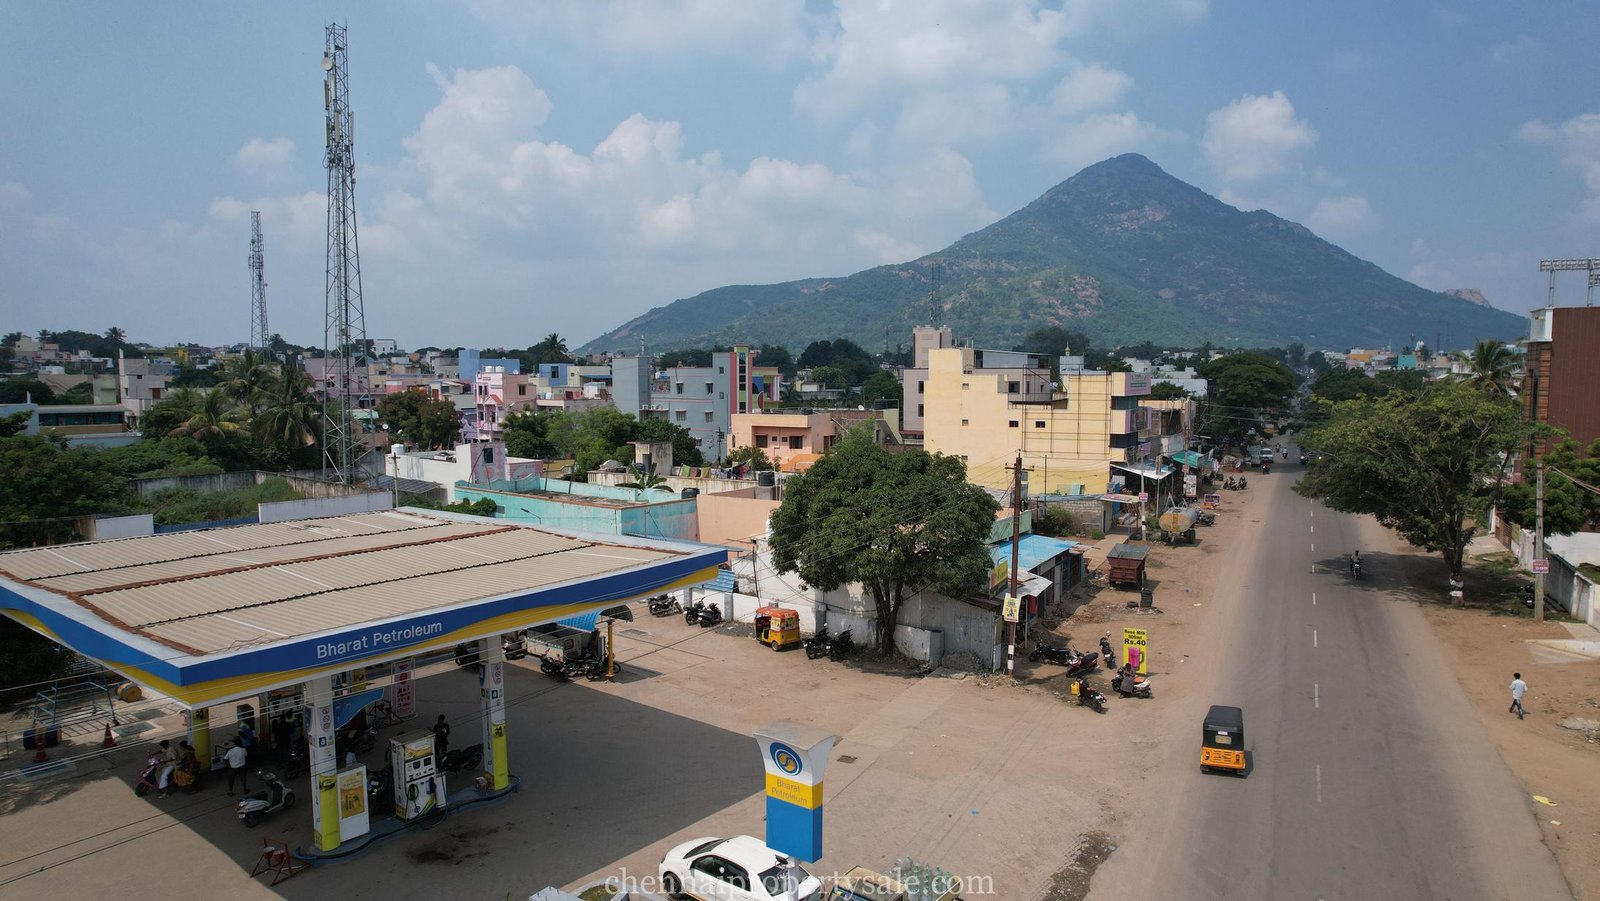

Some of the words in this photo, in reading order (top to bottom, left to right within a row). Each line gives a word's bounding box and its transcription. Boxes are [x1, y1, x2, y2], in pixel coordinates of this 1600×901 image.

[316, 635, 369, 659] Bharat
[373, 621, 442, 646] Petroleum
[1124, 638, 1146, 646] Rs.40
[777, 778, 800, 792] Bharat
[772, 787, 807, 805] Petroleum
